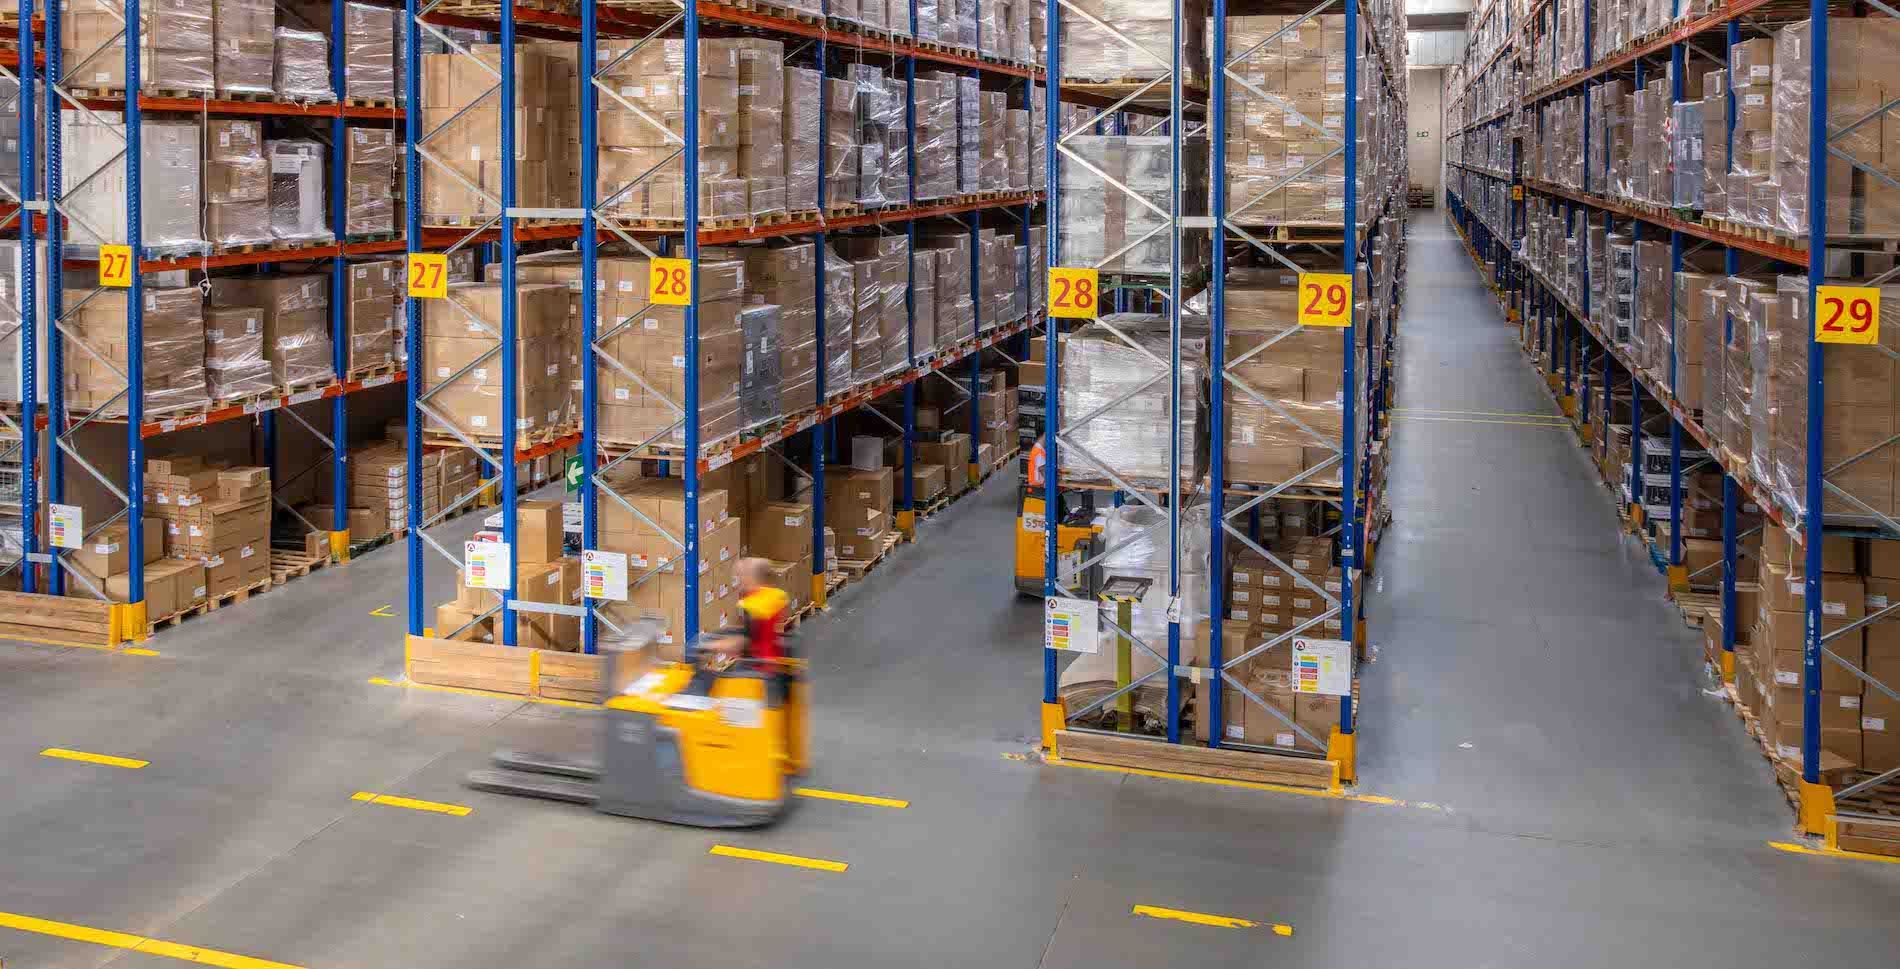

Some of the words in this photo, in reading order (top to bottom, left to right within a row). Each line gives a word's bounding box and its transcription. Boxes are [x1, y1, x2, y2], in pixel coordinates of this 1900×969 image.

[103, 253, 128, 279] 27
[412, 262, 443, 289] 27
[654, 266, 687, 297] 28
[1053, 277, 1094, 309] 28
[1303, 283, 1347, 317] 29
[1821, 296, 1874, 335] 29
